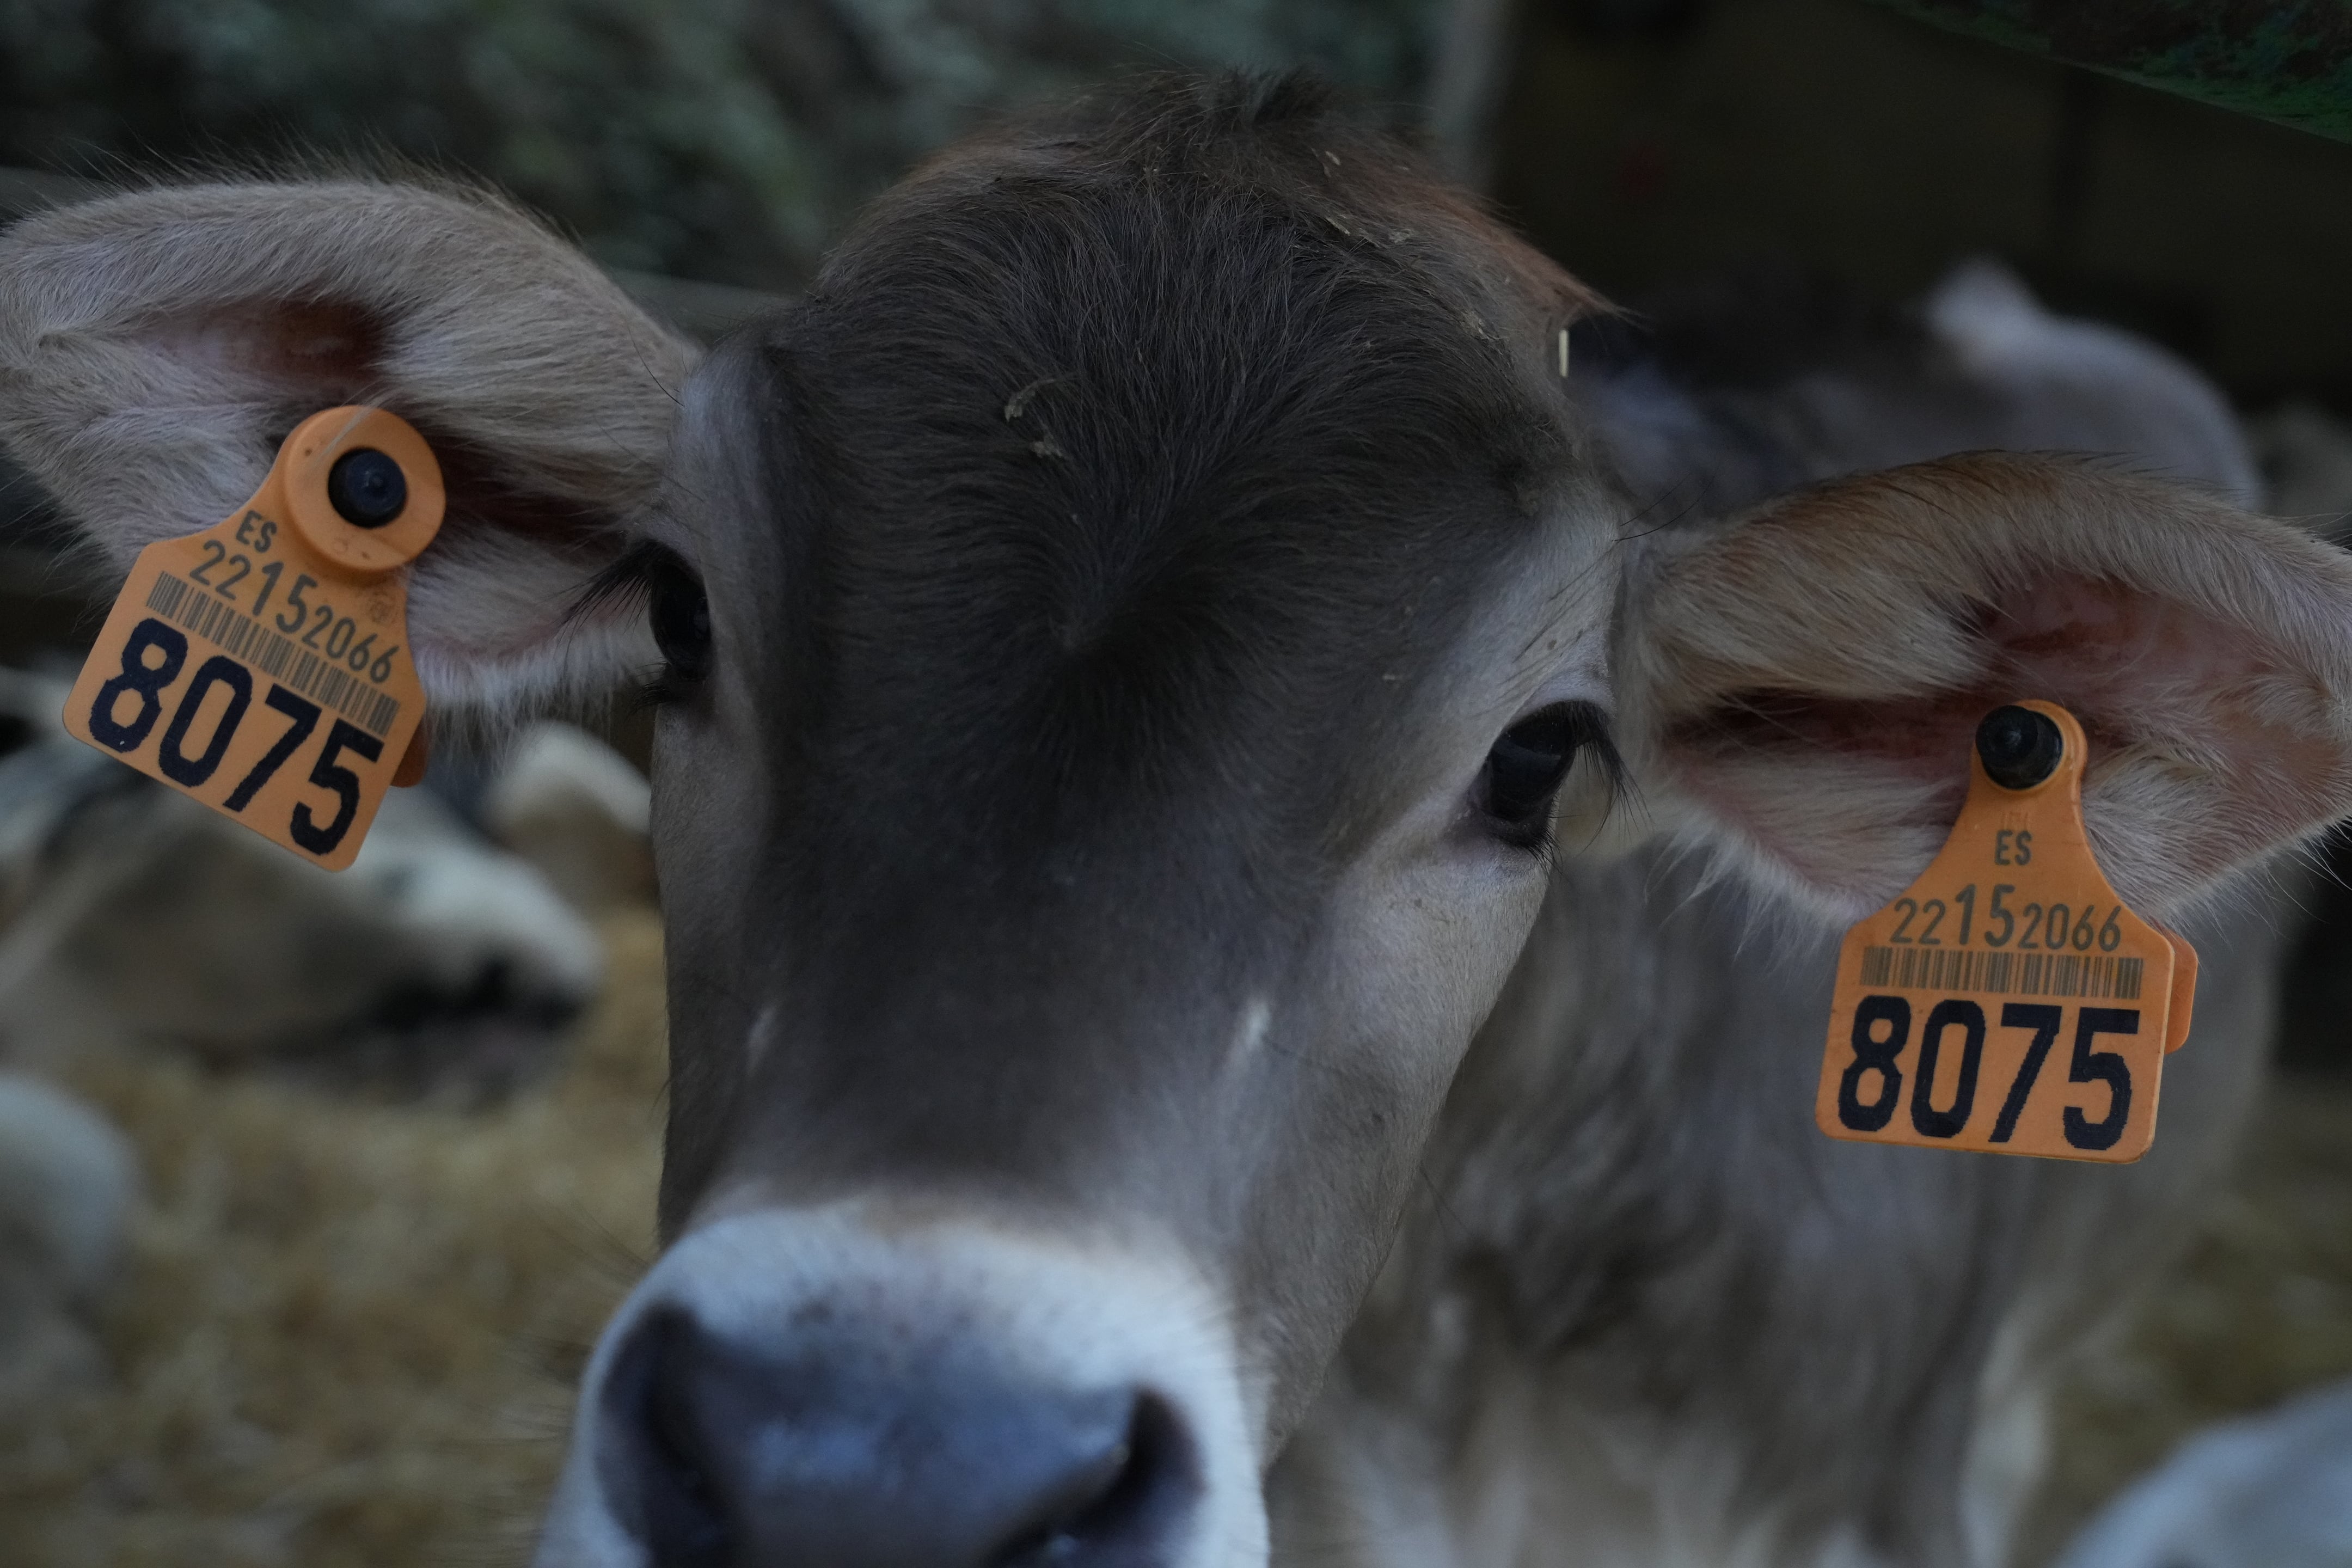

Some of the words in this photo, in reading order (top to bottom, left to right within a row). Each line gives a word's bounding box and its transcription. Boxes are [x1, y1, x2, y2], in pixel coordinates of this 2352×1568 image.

[236, 510, 277, 549] ES
[89, 617, 385, 856] 8075
[1994, 830, 2032, 866] ES
[1837, 995, 2140, 1151] 8075
